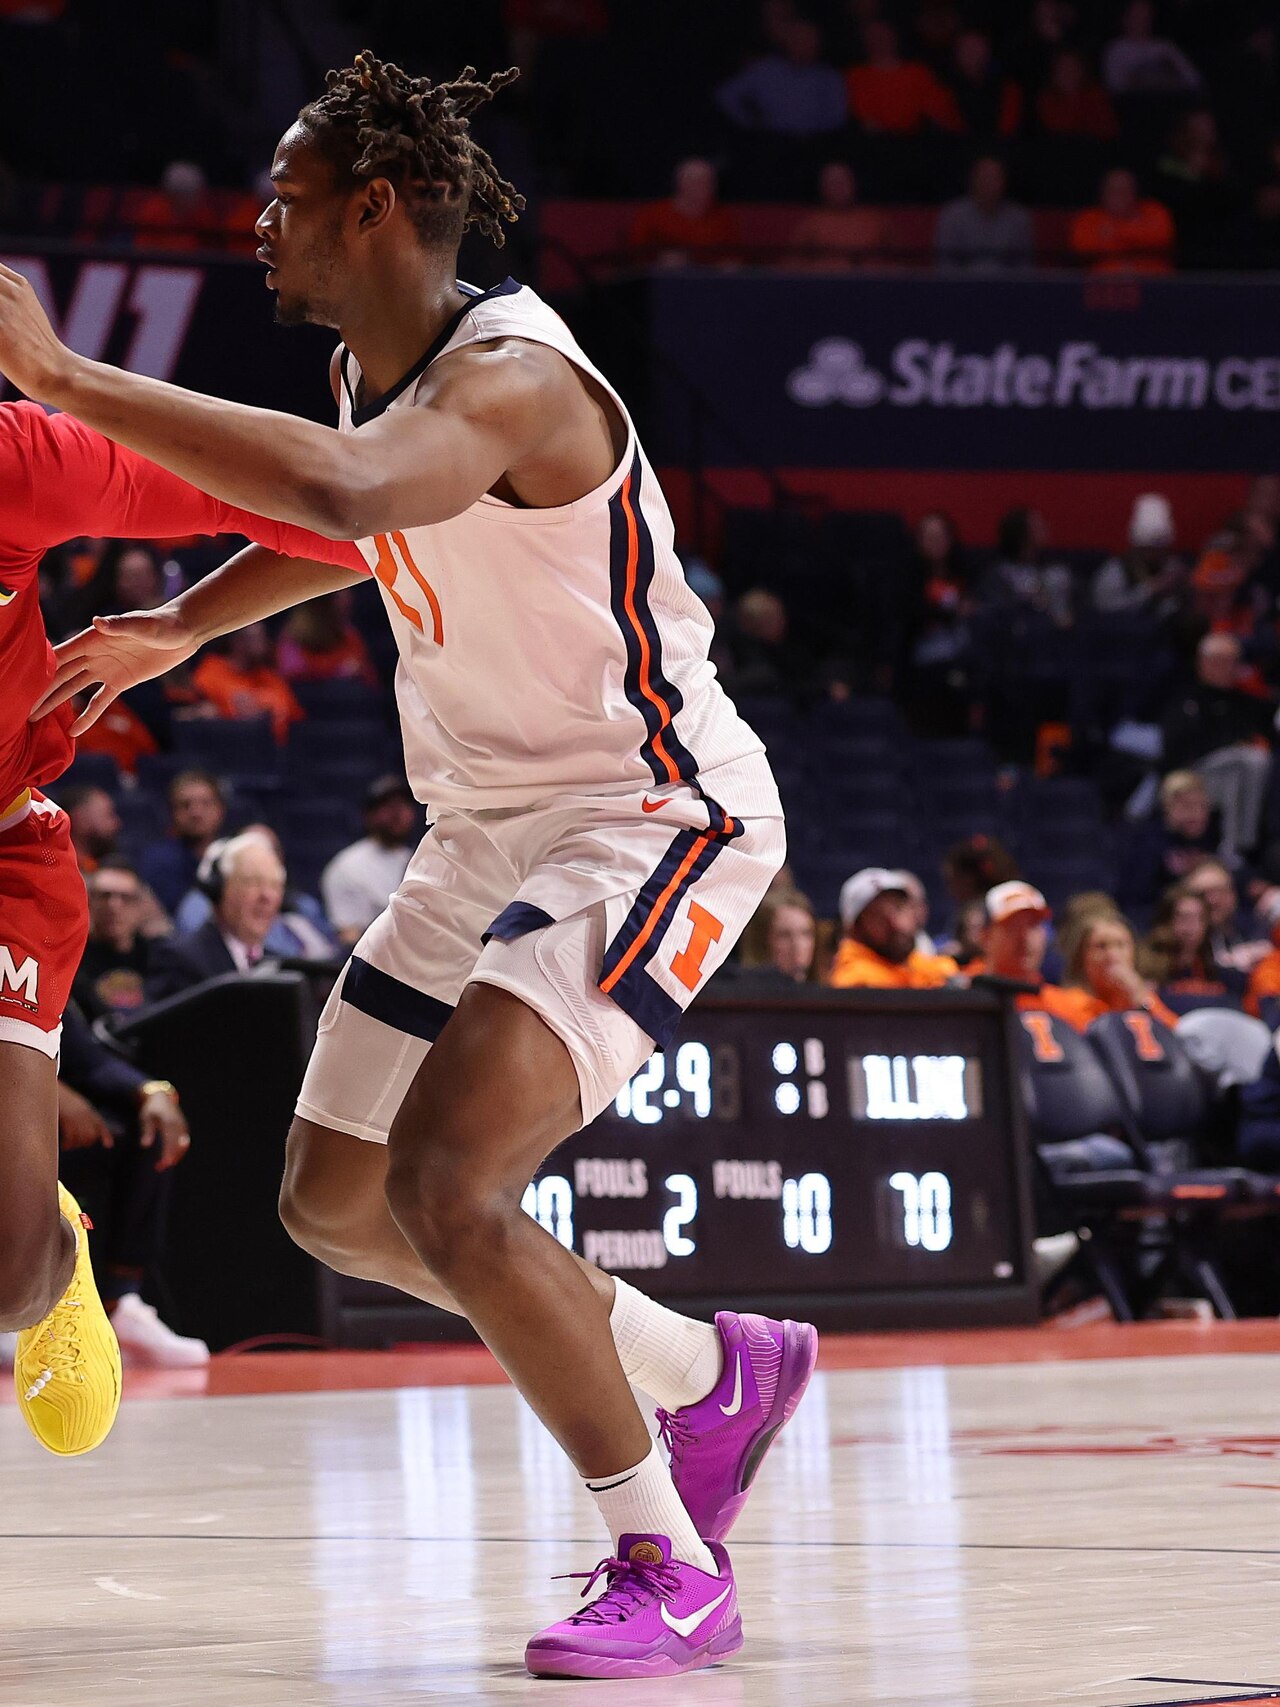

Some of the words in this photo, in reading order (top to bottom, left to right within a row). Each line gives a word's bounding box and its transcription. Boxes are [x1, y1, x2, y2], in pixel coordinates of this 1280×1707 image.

[574, 1158, 649, 1198] FOULS
[712, 1158, 783, 1200] FOULS
[663, 1174, 697, 1256] 2
[782, 1172, 833, 1254] 10
[889, 1171, 952, 1252] 70
[583, 1230, 668, 1270] PERIOD
